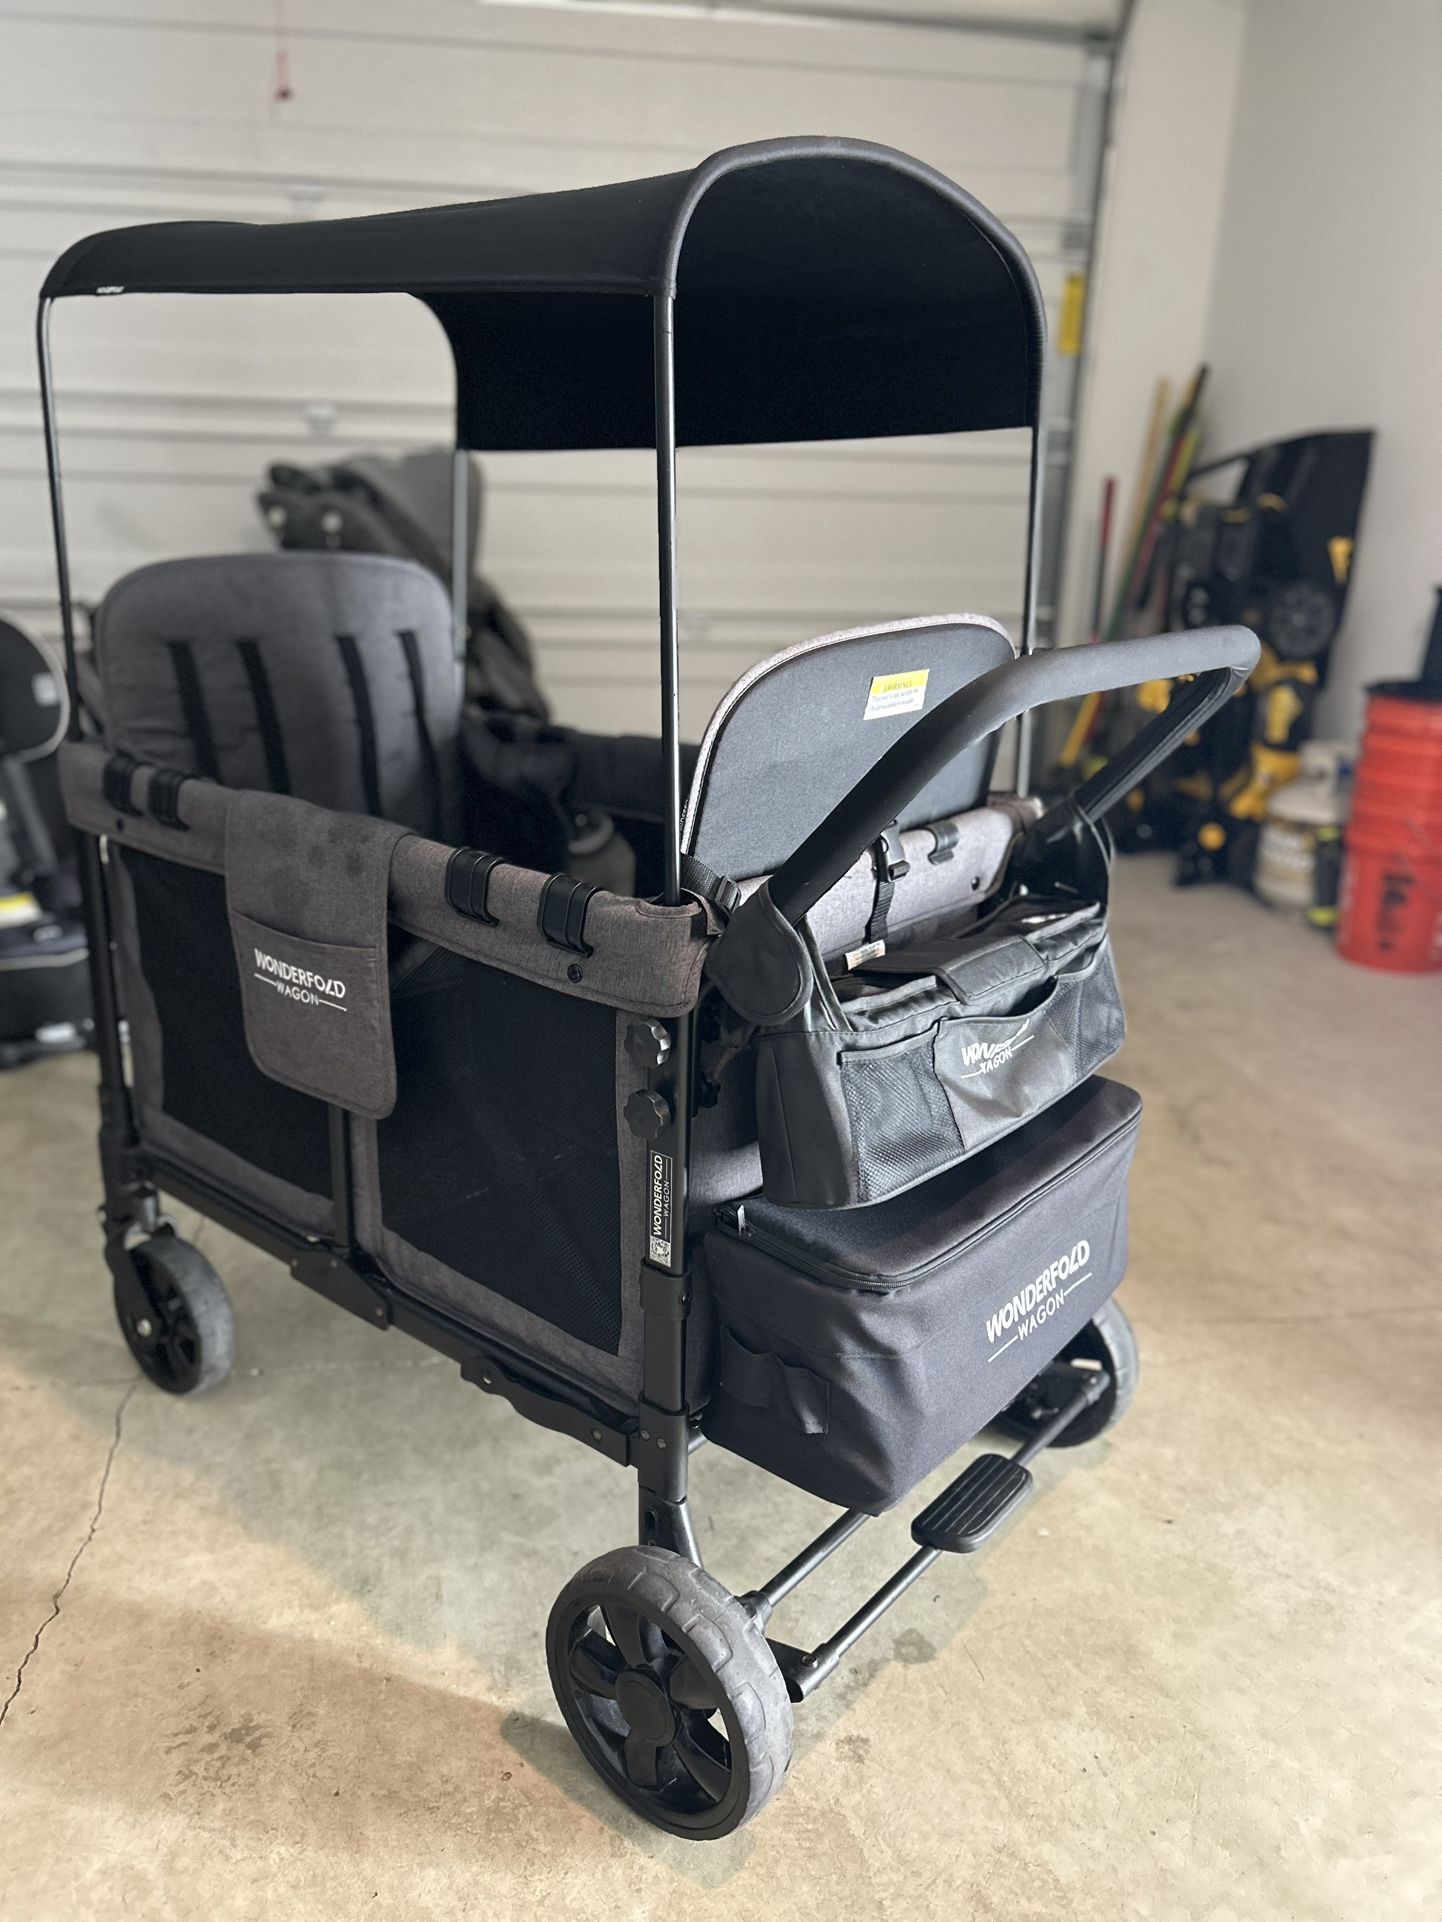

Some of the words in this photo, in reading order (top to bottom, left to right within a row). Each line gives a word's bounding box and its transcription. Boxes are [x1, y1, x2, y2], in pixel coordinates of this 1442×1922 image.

[254, 948, 346, 998] WONDERFOLD
[276, 980, 319, 1006] WAGON
[653, 1154, 663, 1236] WONDERFOLD
[986, 1240, 1090, 1343] WONDERFOLD
[1018, 1288, 1064, 1341] WAGON
